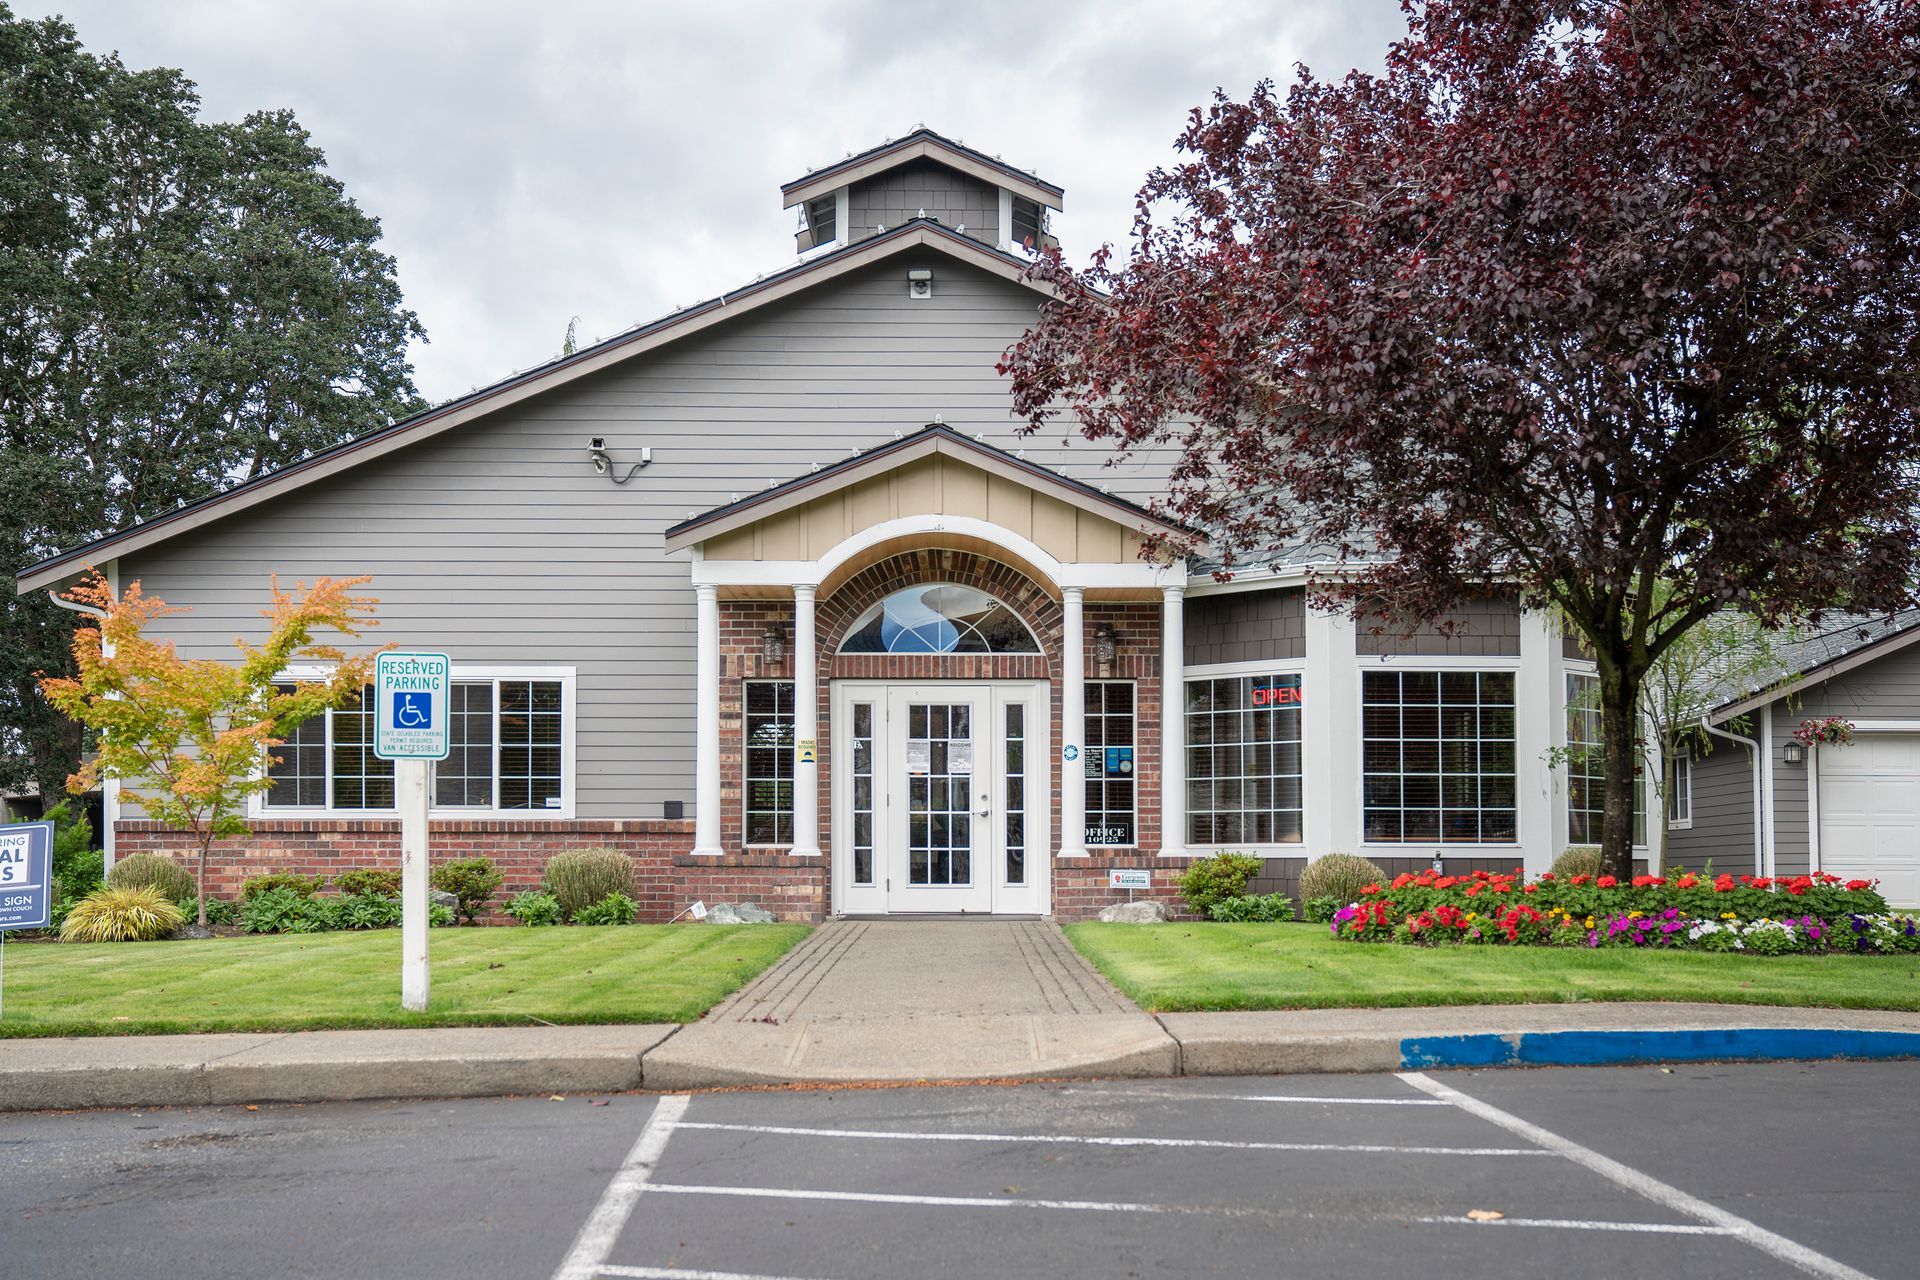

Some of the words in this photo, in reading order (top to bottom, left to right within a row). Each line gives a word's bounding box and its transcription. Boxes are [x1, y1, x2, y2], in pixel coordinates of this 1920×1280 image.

[382, 661, 444, 675] RESERVED
[386, 676, 440, 690] PARKING
[1253, 687, 1302, 705] OPEN
[399, 744, 440, 752] ACCESSIBLE
[2, 866, 14, 881] S
[4, 895, 32, 906] SIGN
